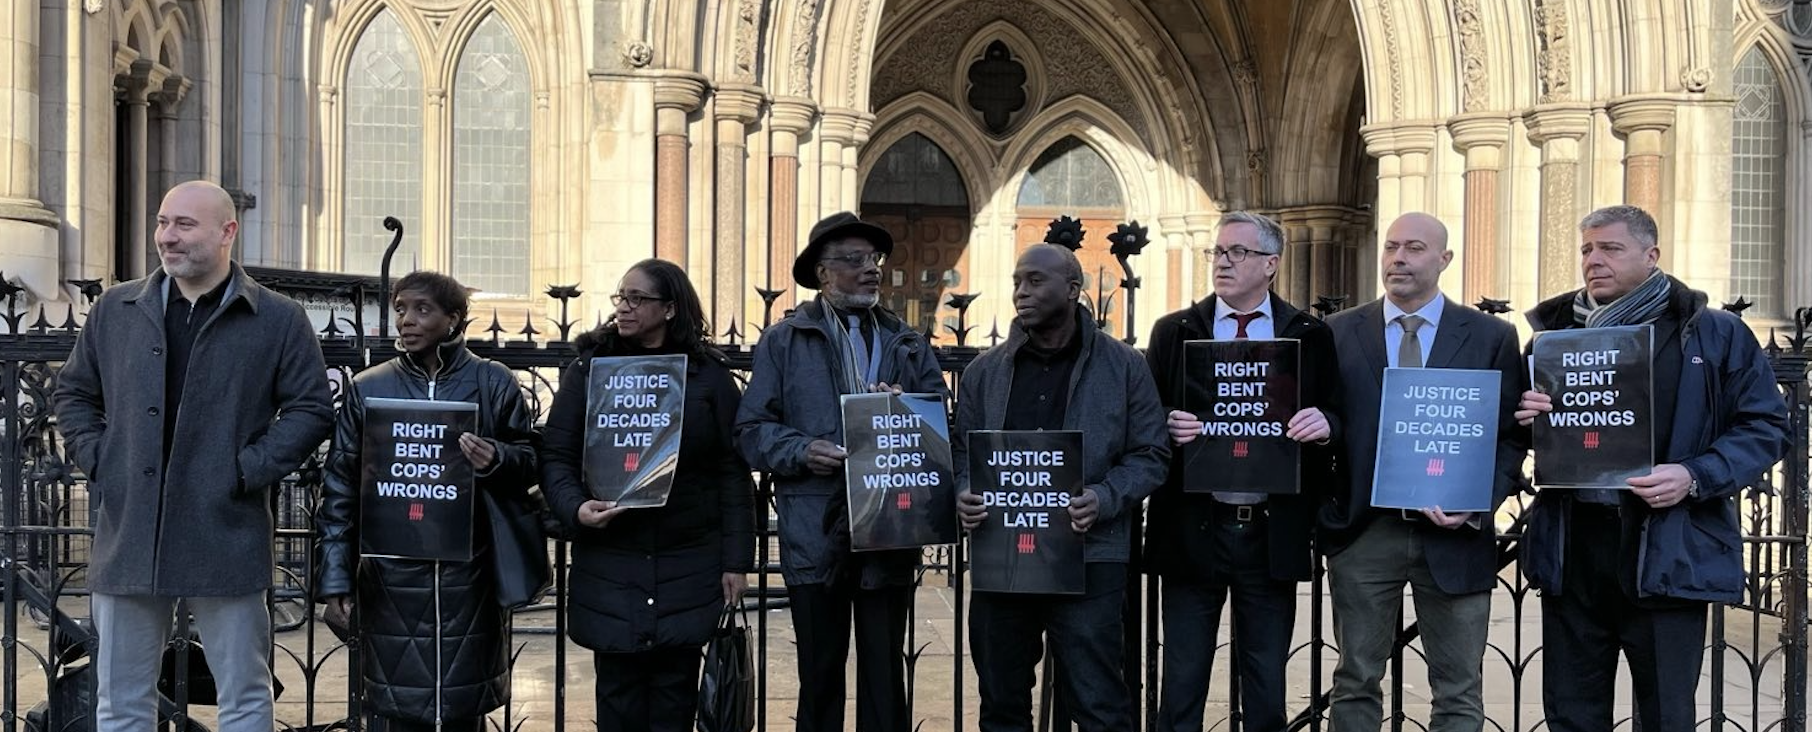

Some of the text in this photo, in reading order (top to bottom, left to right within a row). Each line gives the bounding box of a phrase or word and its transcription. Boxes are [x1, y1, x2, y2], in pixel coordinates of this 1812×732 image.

[1562, 350, 1620, 367] RIGHT
[1214, 362, 1269, 377] RIGHT
[604, 374, 668, 390] JUSTICE
[1566, 370, 1616, 387] BENT
[1217, 381, 1264, 397] BENT
[1403, 386, 1480, 401] JUSTICE
[614, 394, 658, 408] FOUR
[1563, 390, 1619, 407] COPS’
[1213, 401, 1269, 417] COPS’
[1415, 404, 1466, 419] FOUR
[597, 412, 670, 428] DECADES
[872, 414, 922, 430] RIGHT
[1549, 409, 1635, 427] WRONGS
[392, 422, 447, 439] RIGHT
[1201, 421, 1283, 436] WRONGS
[1395, 421, 1483, 437] DECADES
[613, 432, 652, 447] LATE
[877, 433, 922, 449] BENT
[1414, 439, 1460, 455] LATE
[395, 442, 444, 459] BENT
[874, 452, 926, 469] COPS’
[988, 451, 1063, 467] JUSTICE
[391, 462, 446, 479] COPS’
[863, 471, 939, 487] WRONGS
[1000, 471, 1052, 487] FOUR
[377, 481, 457, 500] WRONGS
[983, 491, 1070, 508] DECADES
[1004, 512, 1049, 527] LATE
